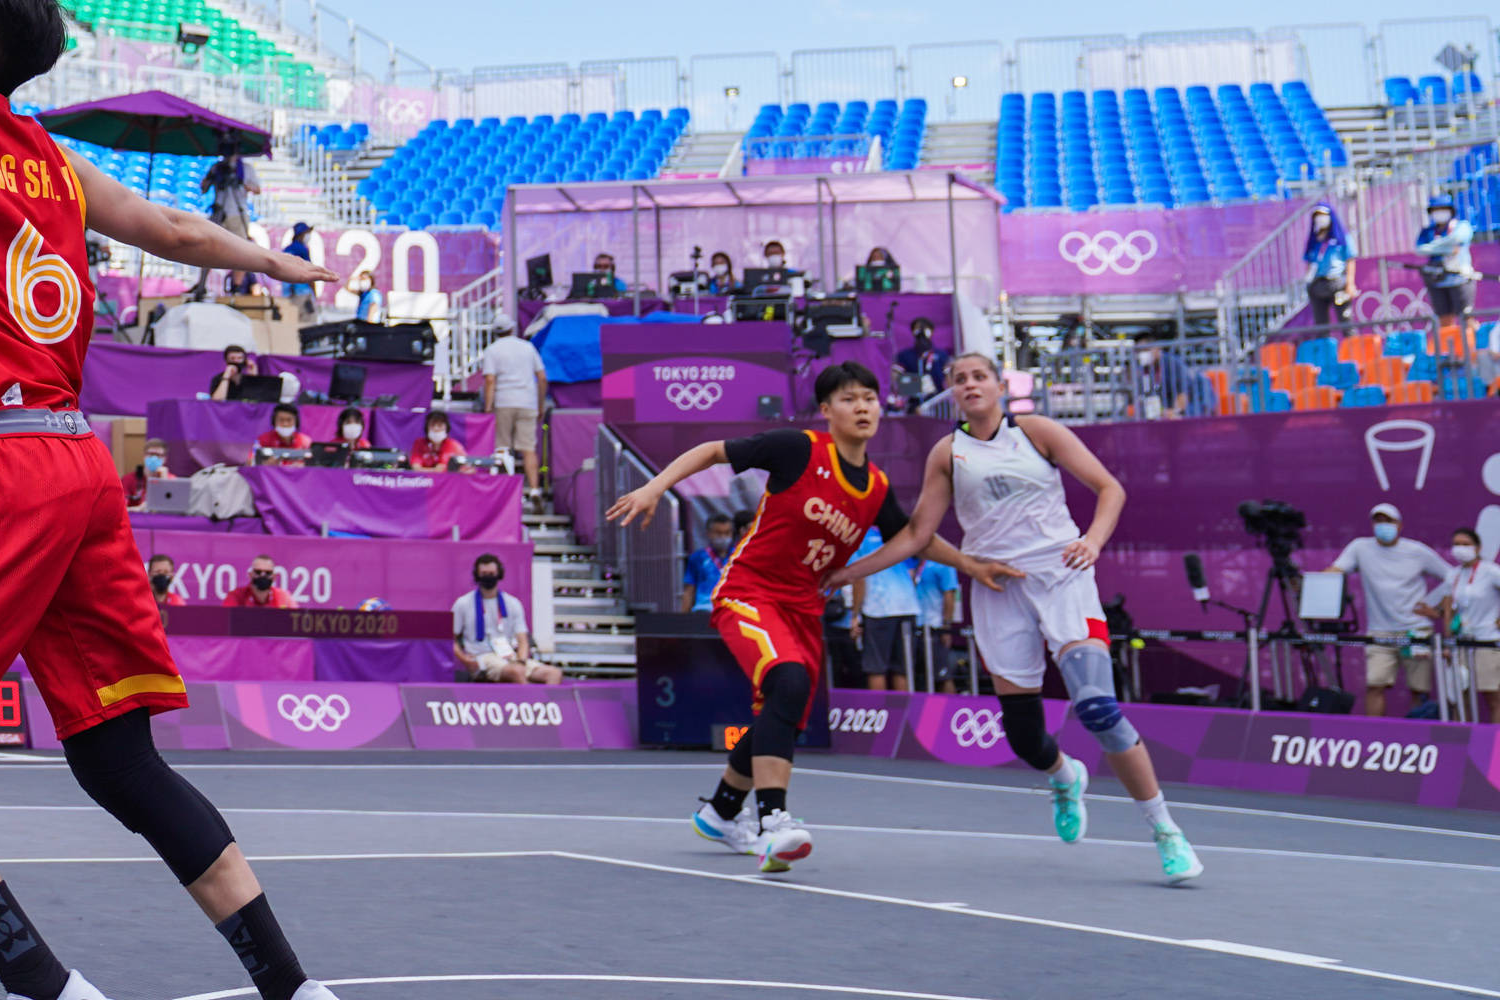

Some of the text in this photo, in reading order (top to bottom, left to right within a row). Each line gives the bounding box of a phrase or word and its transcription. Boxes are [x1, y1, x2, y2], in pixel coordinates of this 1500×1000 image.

[5, 217, 82, 345] 6
[653, 365, 736, 381] TOKYO 2020
[353, 473, 434, 489] United by Emotion
[801, 539, 836, 572] 13
[289, 611, 398, 634] TOKYO 2020
[655, 675, 676, 707] 3
[426, 701, 562, 726] TOKYO 2020
[840, 708, 889, 733] 2020
[1271, 734, 1439, 775] TOKYO 2020
